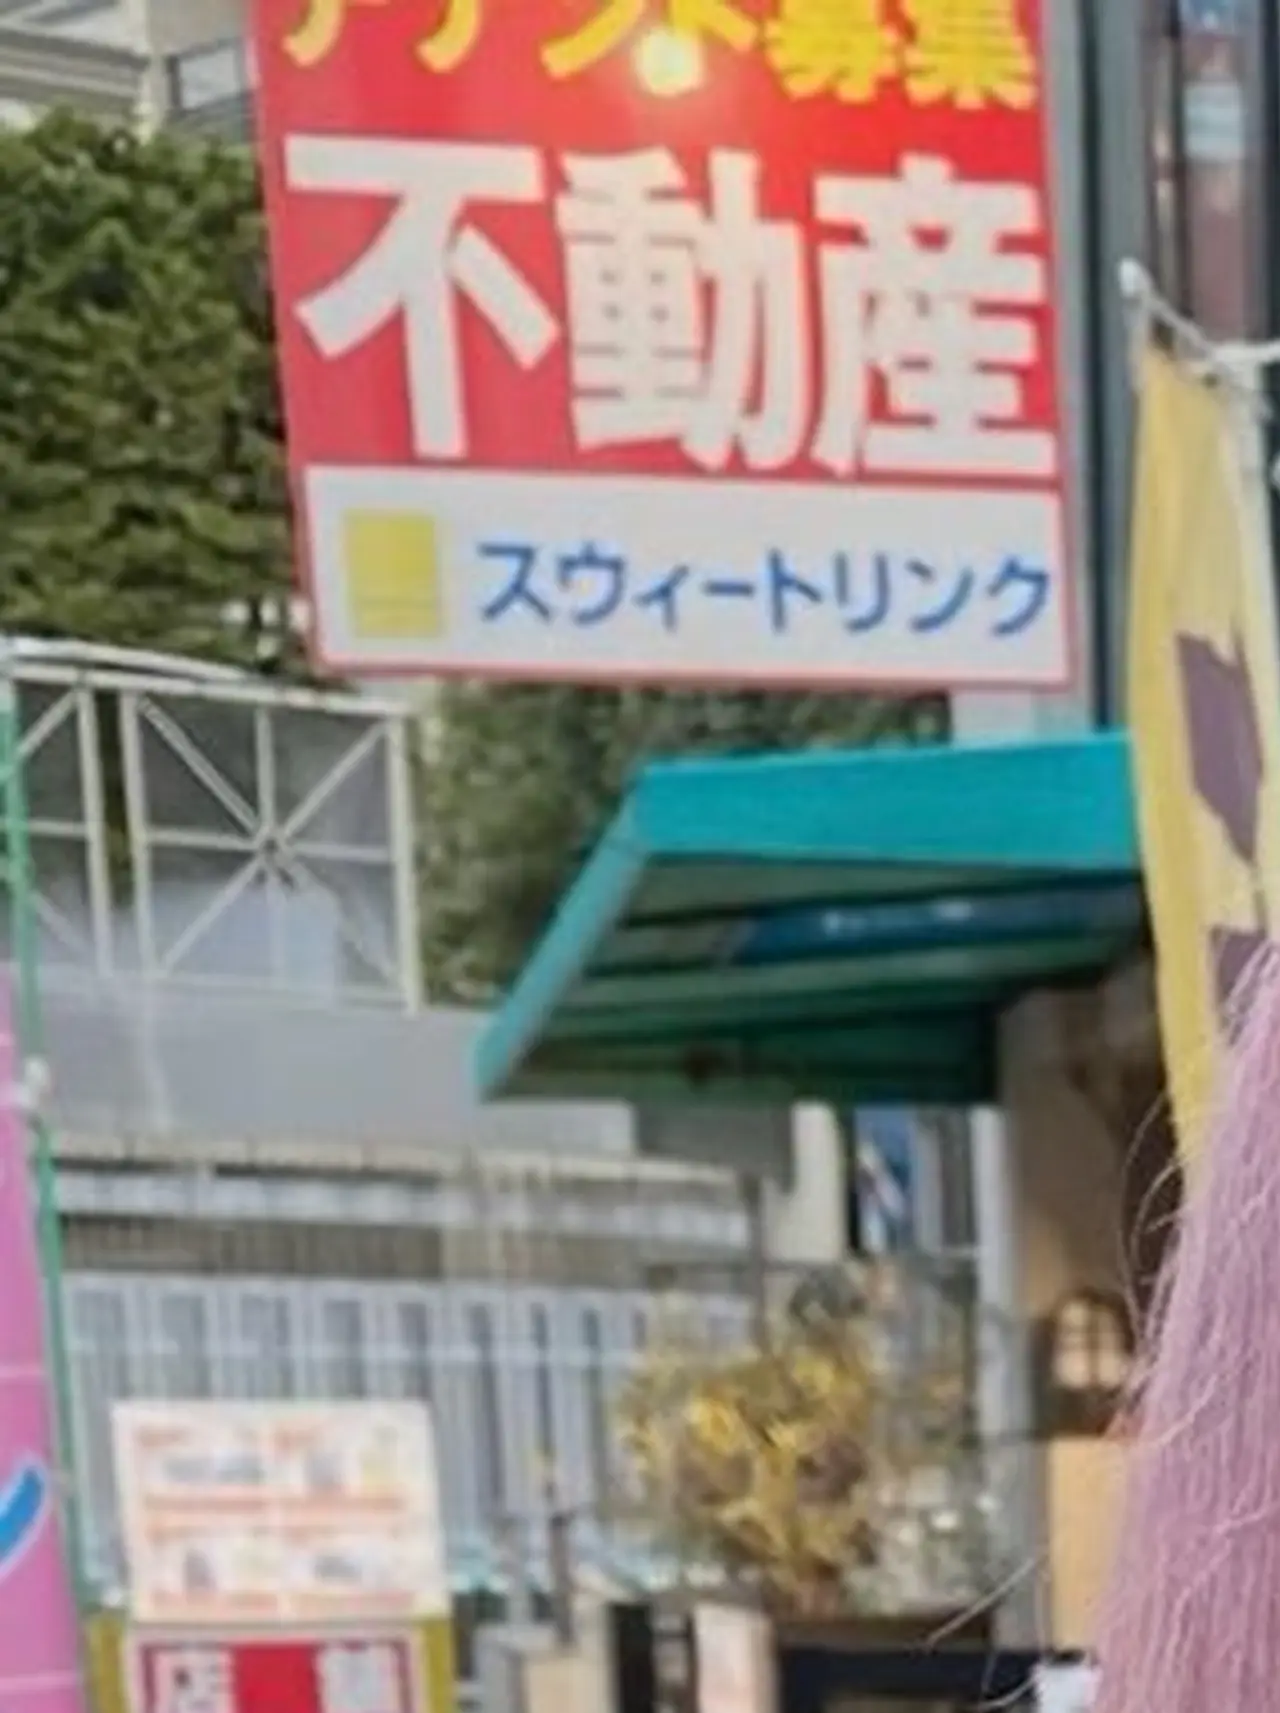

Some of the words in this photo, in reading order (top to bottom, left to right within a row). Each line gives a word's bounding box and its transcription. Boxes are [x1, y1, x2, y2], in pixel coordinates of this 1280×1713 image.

[284, 133, 1058, 476] 不動産
[478, 538, 1050, 640] スウィートリンク
